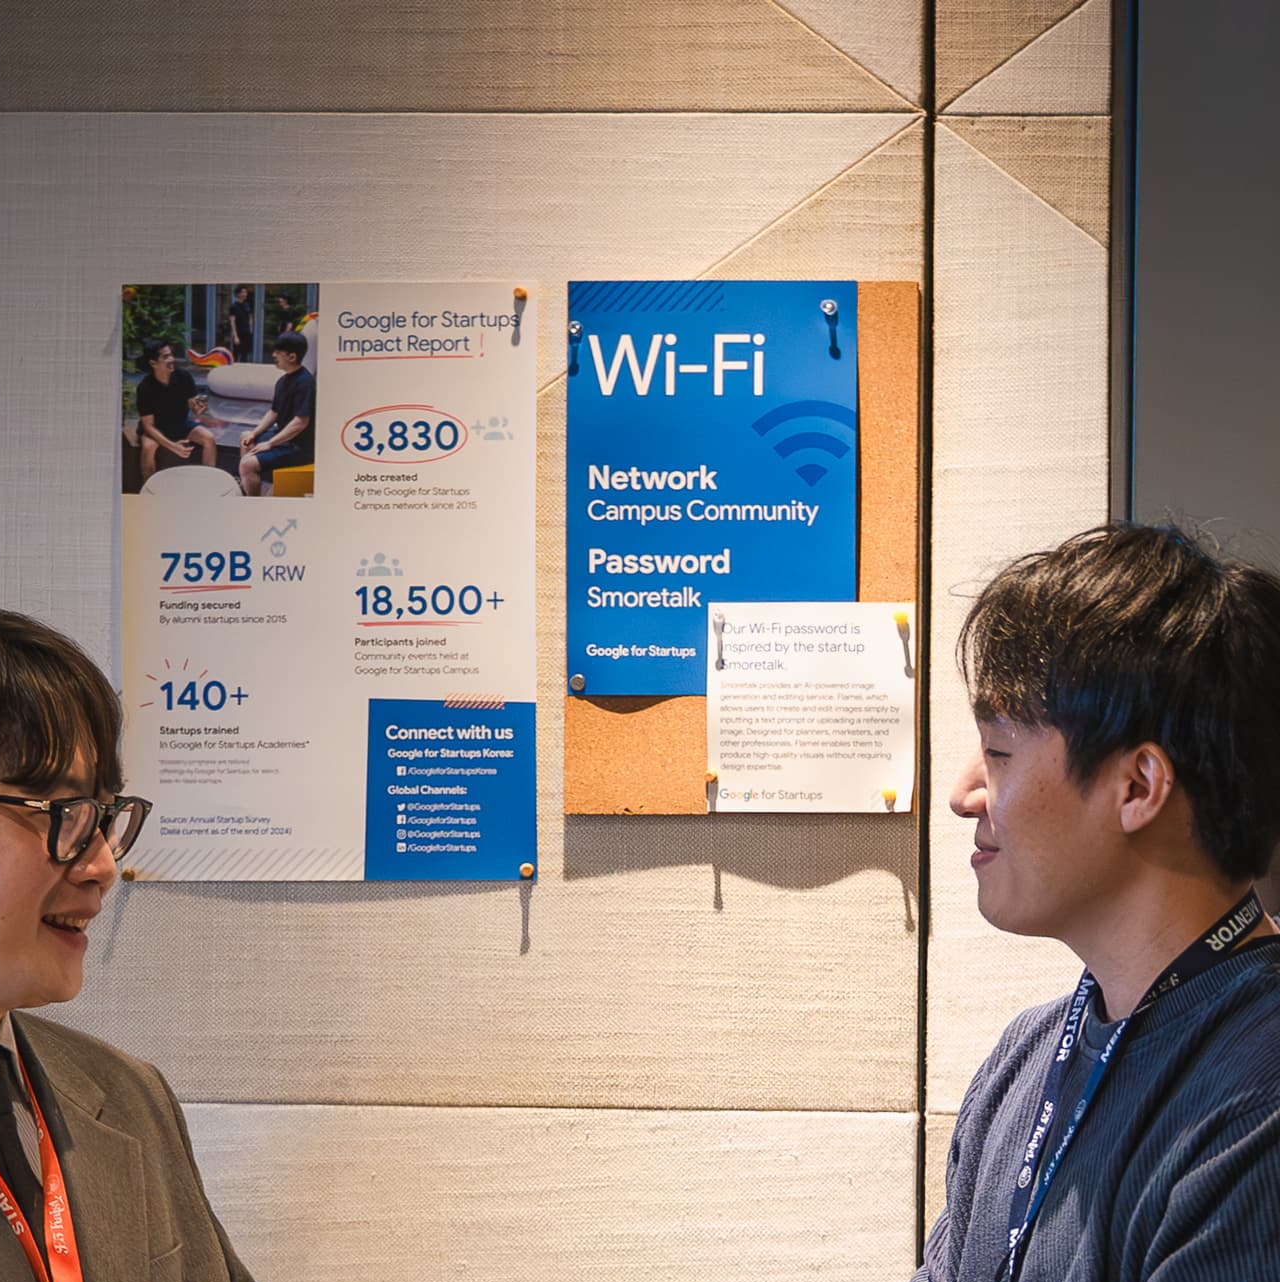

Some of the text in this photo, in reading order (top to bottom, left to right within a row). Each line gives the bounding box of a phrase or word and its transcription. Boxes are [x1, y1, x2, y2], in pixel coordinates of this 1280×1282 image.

[338, 311, 520, 333] Google for Startups
[338, 335, 470, 356] Impact Report
[588, 333, 765, 396] Wi-Fi
[353, 420, 459, 455] 3,830
[354, 473, 418, 482] Jobs created
[588, 464, 717, 490] Network
[354, 488, 364, 497] By
[367, 488, 382, 496] the
[384, 488, 416, 497] Google
[432, 487, 470, 497] Startups
[354, 502, 390, 512] Campus
[392, 501, 428, 509] network
[587, 499, 819, 527] Campus Community
[160, 551, 305, 582] 759B KRW
[588, 548, 730, 574] Password
[355, 585, 504, 619] 18,500+
[587, 586, 702, 608] Smoretalk
[160, 601, 240, 611] Funding secured
[160, 615, 287, 625] By alumni startups since 2015
[722, 623, 861, 636] Our Wi-Fi password is
[355, 638, 446, 648] Participants joined
[775, 642, 789, 654] by
[793, 641, 813, 652] the
[818, 642, 865, 654] startup
[355, 652, 406, 662] Community
[439, 652, 458, 660] held
[460, 652, 469, 660] at
[586, 644, 696, 659] Google for Startups
[355, 666, 479, 676] Google for Startups Campus
[160, 680, 248, 711] 140+
[864, 705, 888, 713] simply
[890, 705, 900, 713] by
[160, 726, 239, 736] Startups trained
[385, 725, 513, 740] Connect with us
[747, 729, 782, 737] Designed
[160, 741, 168, 749] In
[169, 741, 202, 750] Google
[218, 741, 255, 750] Startups
[388, 749, 513, 760] Google for Startups Korea:
[720, 752, 751, 760] produce
[857, 752, 891, 760] requiring
[387, 785, 467, 795] Global Channels:
[720, 788, 823, 801] Google for Startups
[217, 816, 243, 824] Startup
[245, 816, 270, 824] Survey
[1205, 899, 1261, 953] MENTOR
[1055, 978, 1095, 1062] MENTOR
